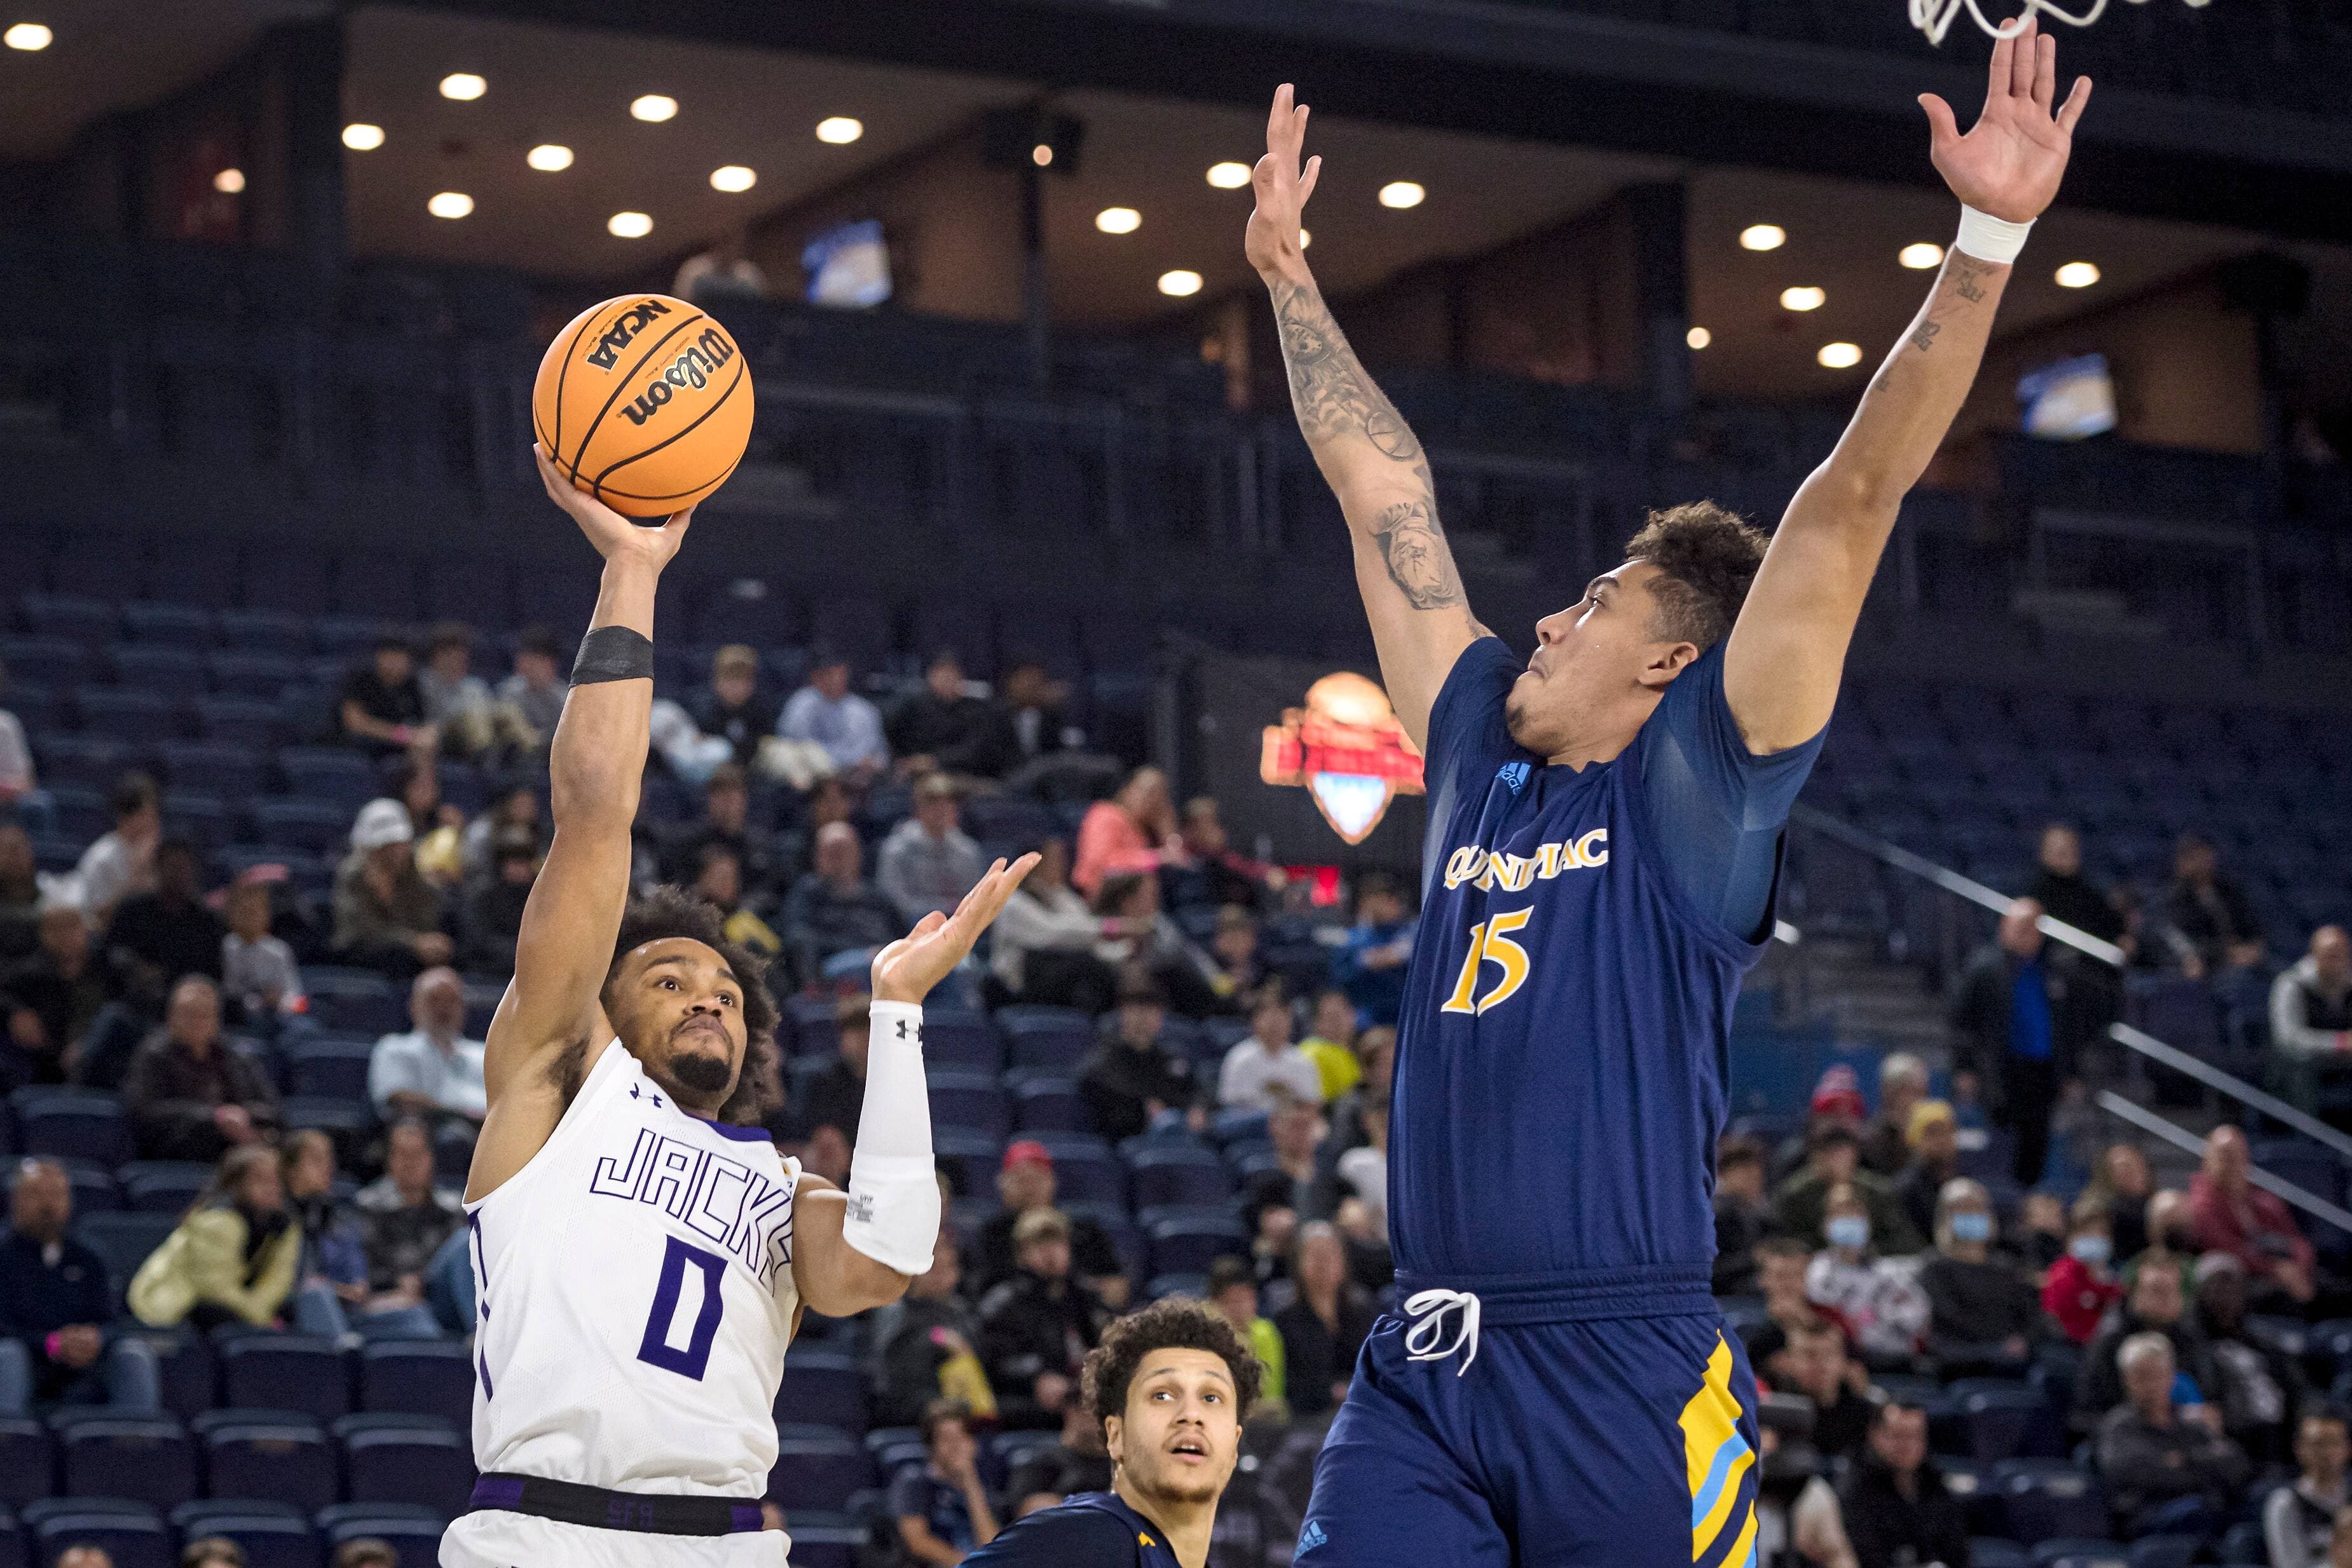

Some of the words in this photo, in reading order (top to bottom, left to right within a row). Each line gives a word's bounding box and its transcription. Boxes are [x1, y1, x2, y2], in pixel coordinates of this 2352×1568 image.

[587, 299, 672, 370] NCAA
[621, 328, 735, 426] Wilson
[1440, 904, 1535, 1018] 15
[636, 1234, 729, 1382] 0
